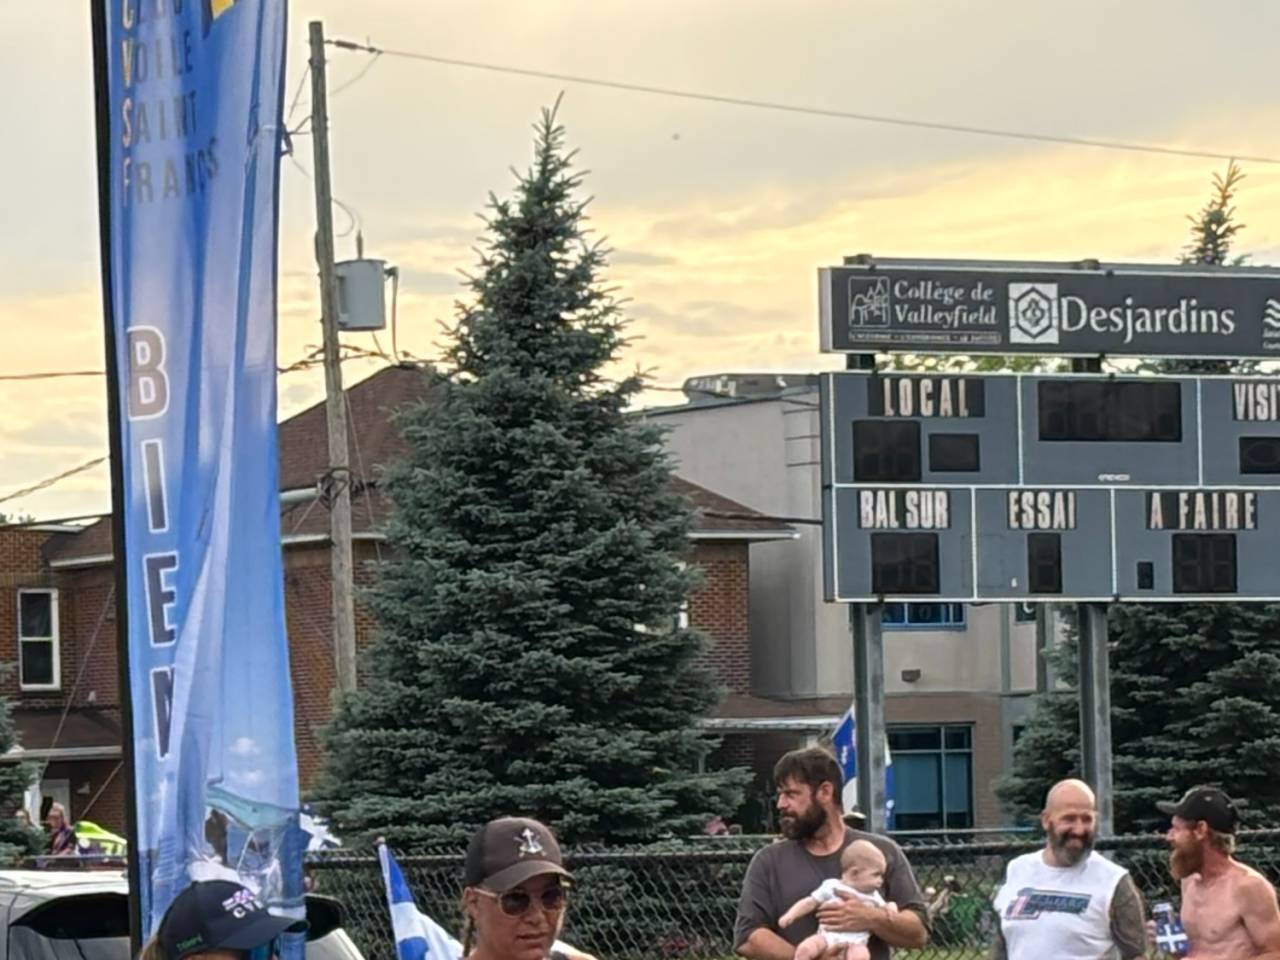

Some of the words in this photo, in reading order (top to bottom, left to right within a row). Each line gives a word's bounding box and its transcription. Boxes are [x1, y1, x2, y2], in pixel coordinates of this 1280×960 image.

[893, 280, 965, 305] Collège
[971, 281, 993, 301] de
[894, 304, 998, 329] Valleyfield
[1060, 296, 1235, 344] Desjardins
[883, 378, 969, 417] LOCAL
[860, 490, 899, 529] BAL
[905, 490, 949, 529] SUR
[1008, 491, 1075, 529] ESSAI
[1179, 492, 1255, 529] FAIRE
